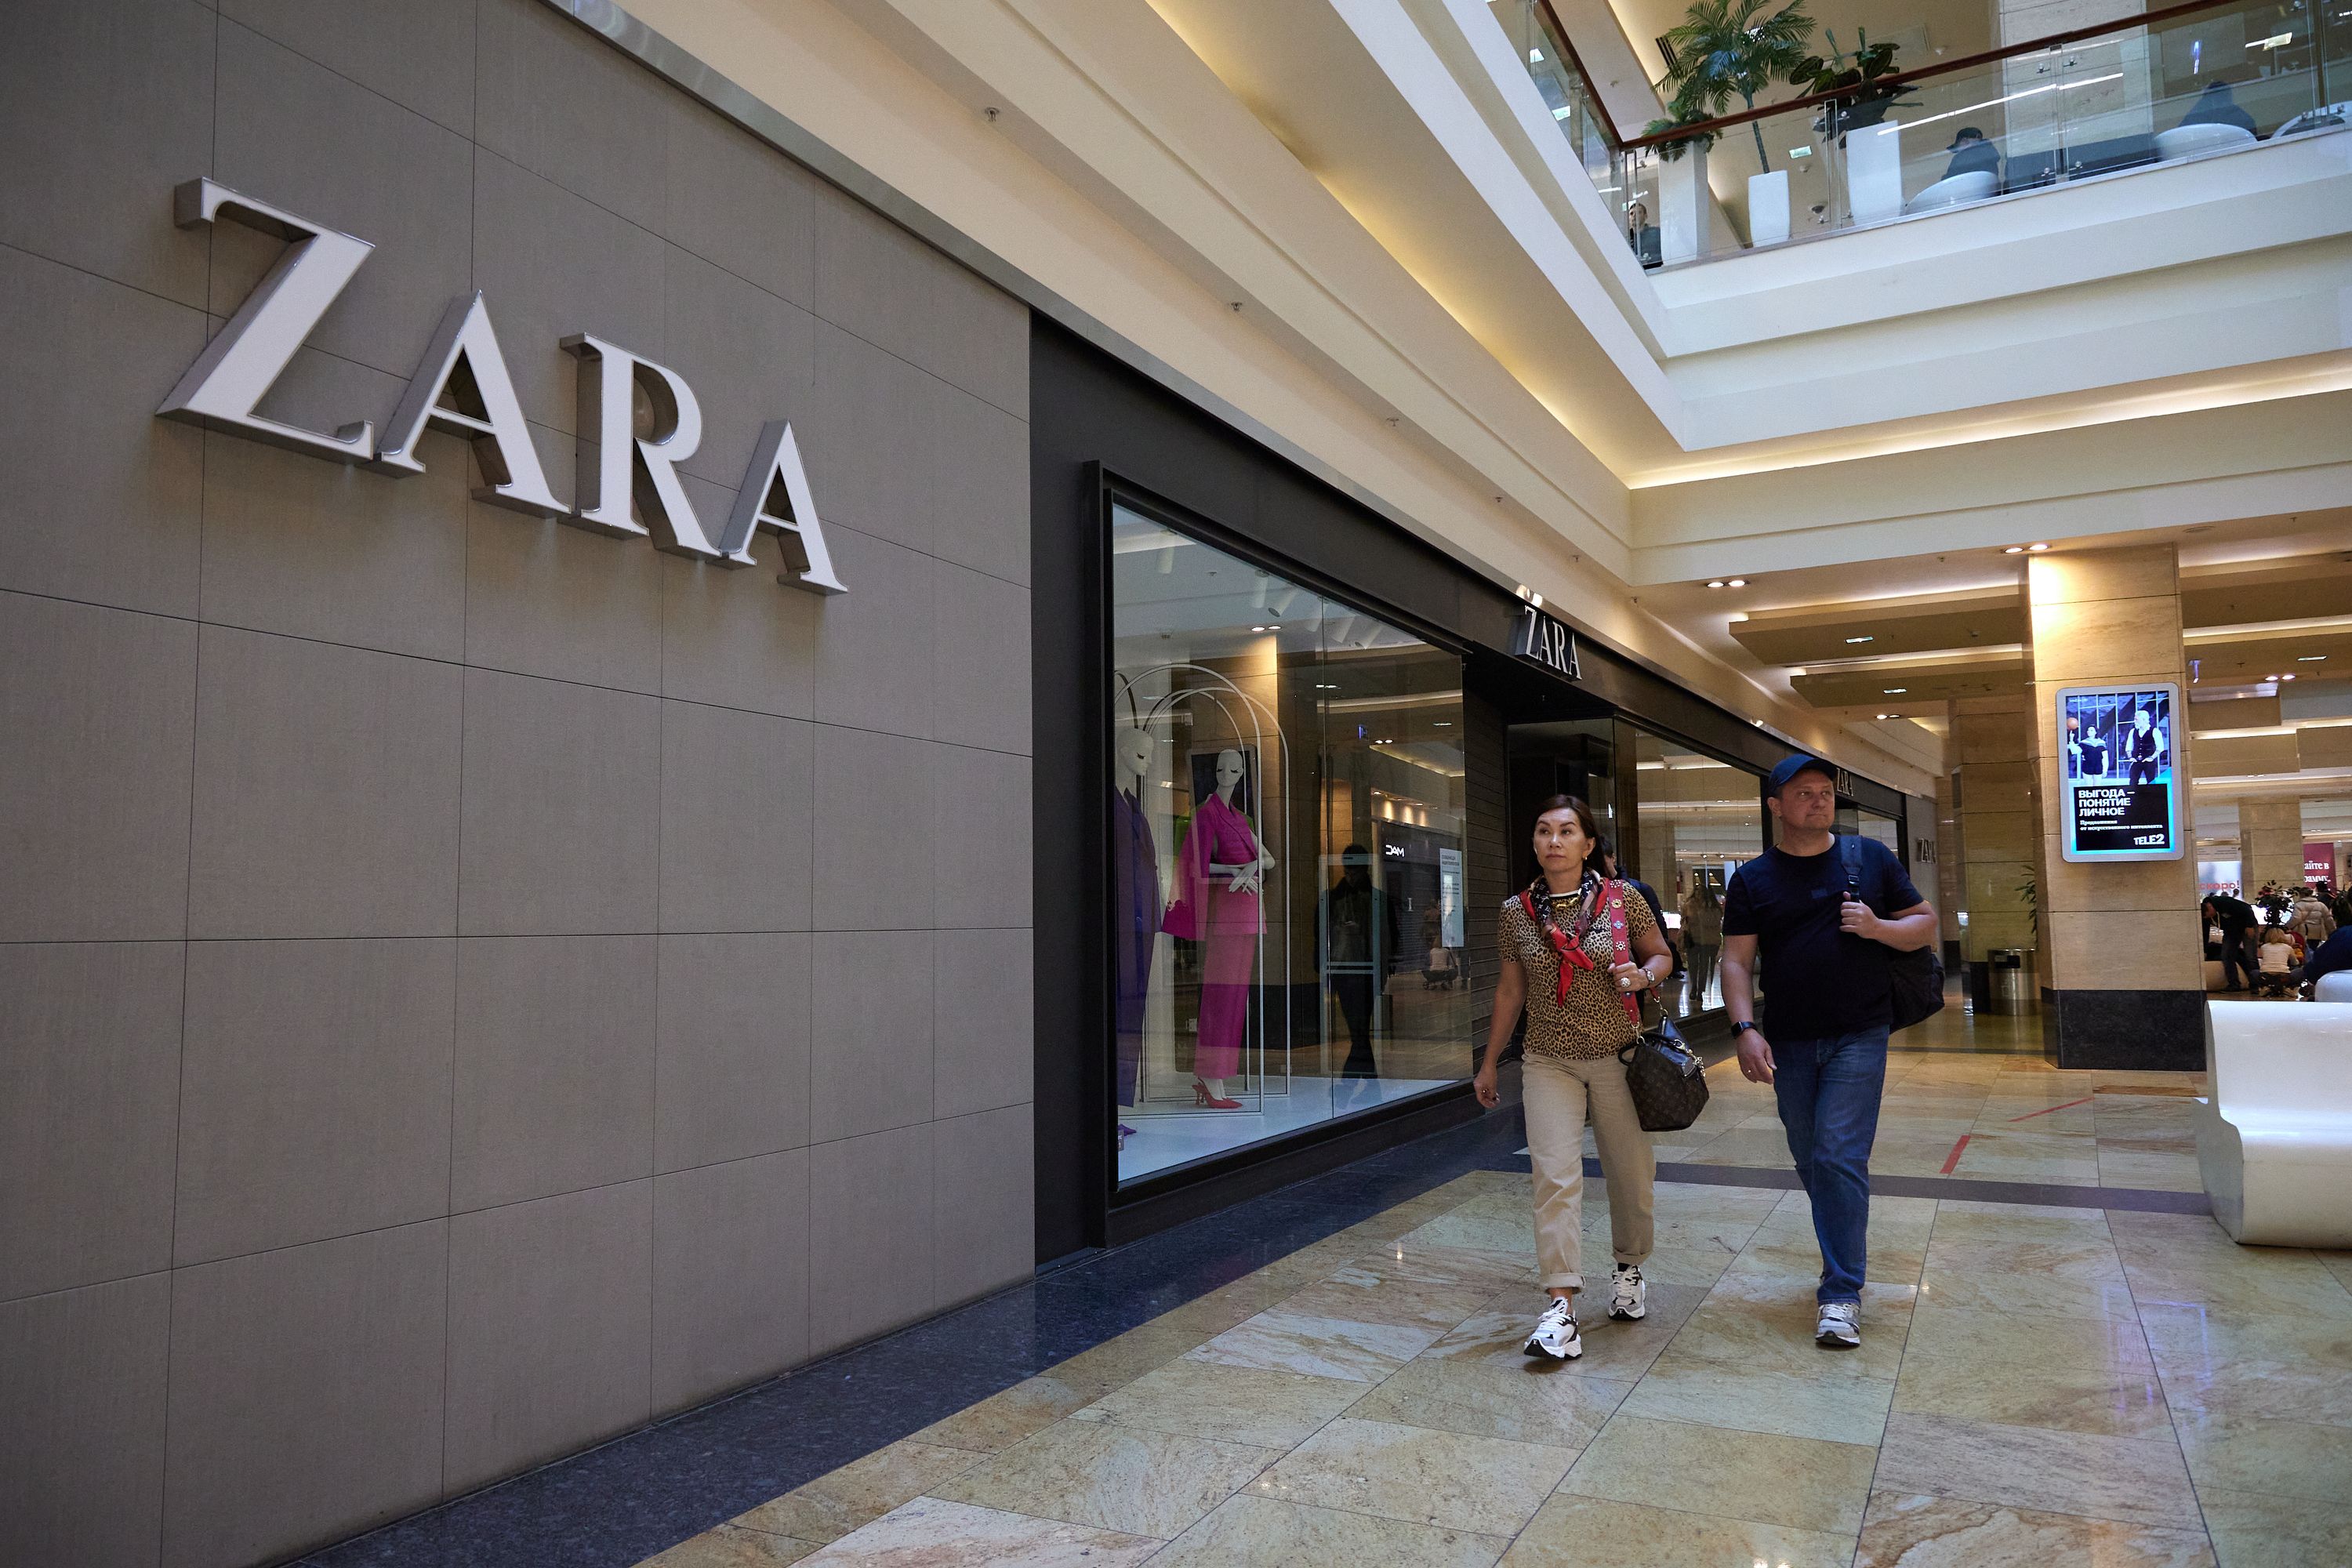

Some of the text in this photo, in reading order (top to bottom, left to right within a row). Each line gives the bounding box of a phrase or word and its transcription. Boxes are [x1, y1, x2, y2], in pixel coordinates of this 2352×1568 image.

[157, 177, 848, 596] ZARA
[1515, 604, 1582, 680] ZARA
[2078, 789, 2125, 799] ВЫГОДА
[2078, 797, 2132, 808] ПОНЯТИЕ
[2079, 808, 2125, 816] ЛИЧНОЕ
[2133, 833, 2165, 845] TELE2
